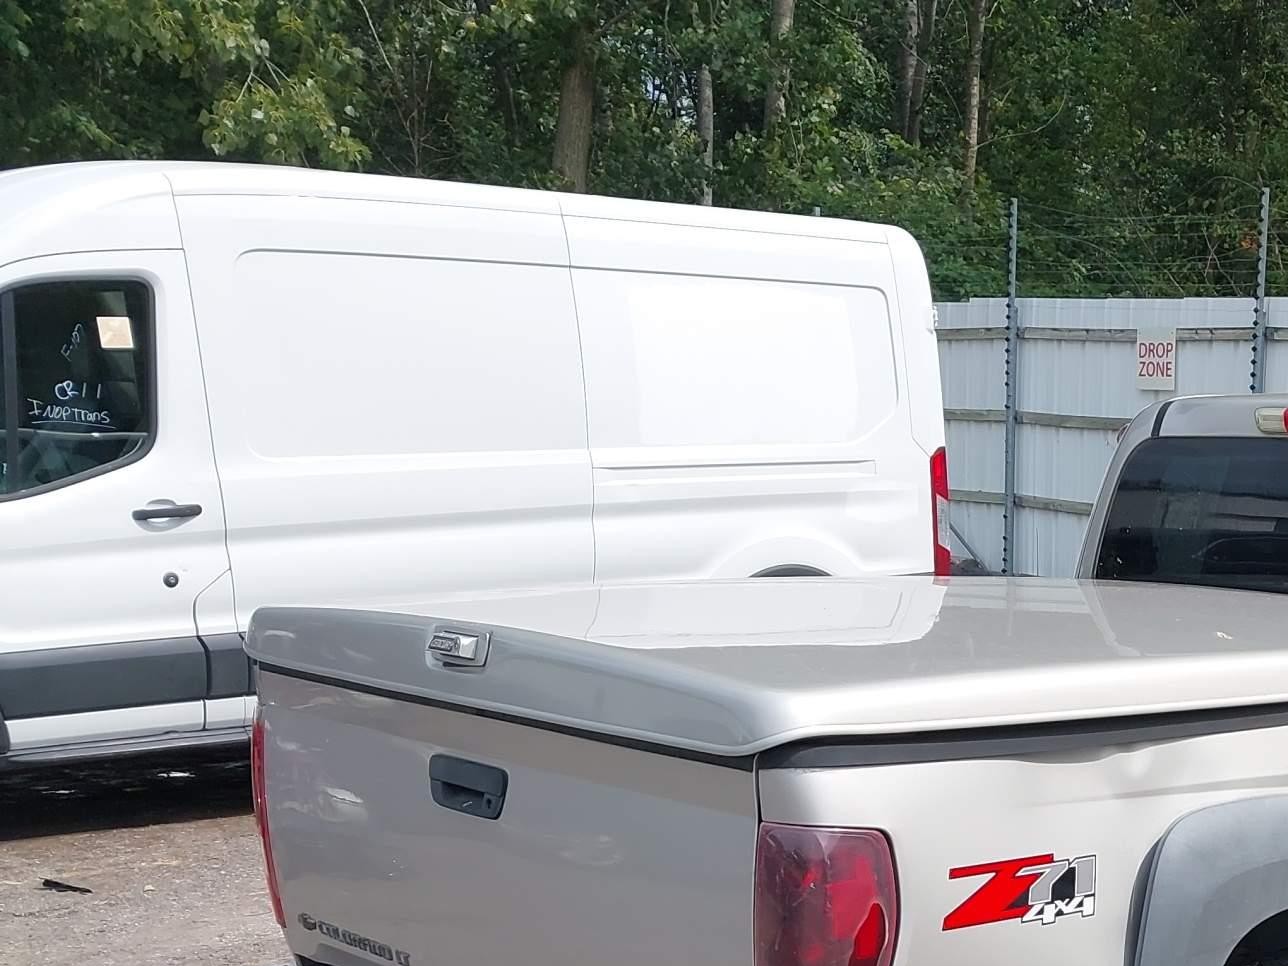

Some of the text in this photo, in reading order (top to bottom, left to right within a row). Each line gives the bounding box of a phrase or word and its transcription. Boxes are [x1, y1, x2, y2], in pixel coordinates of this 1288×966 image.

[1138, 342, 1174, 359] DROP
[1138, 361, 1173, 378] ZONE
[942, 853, 1097, 931] Z71
